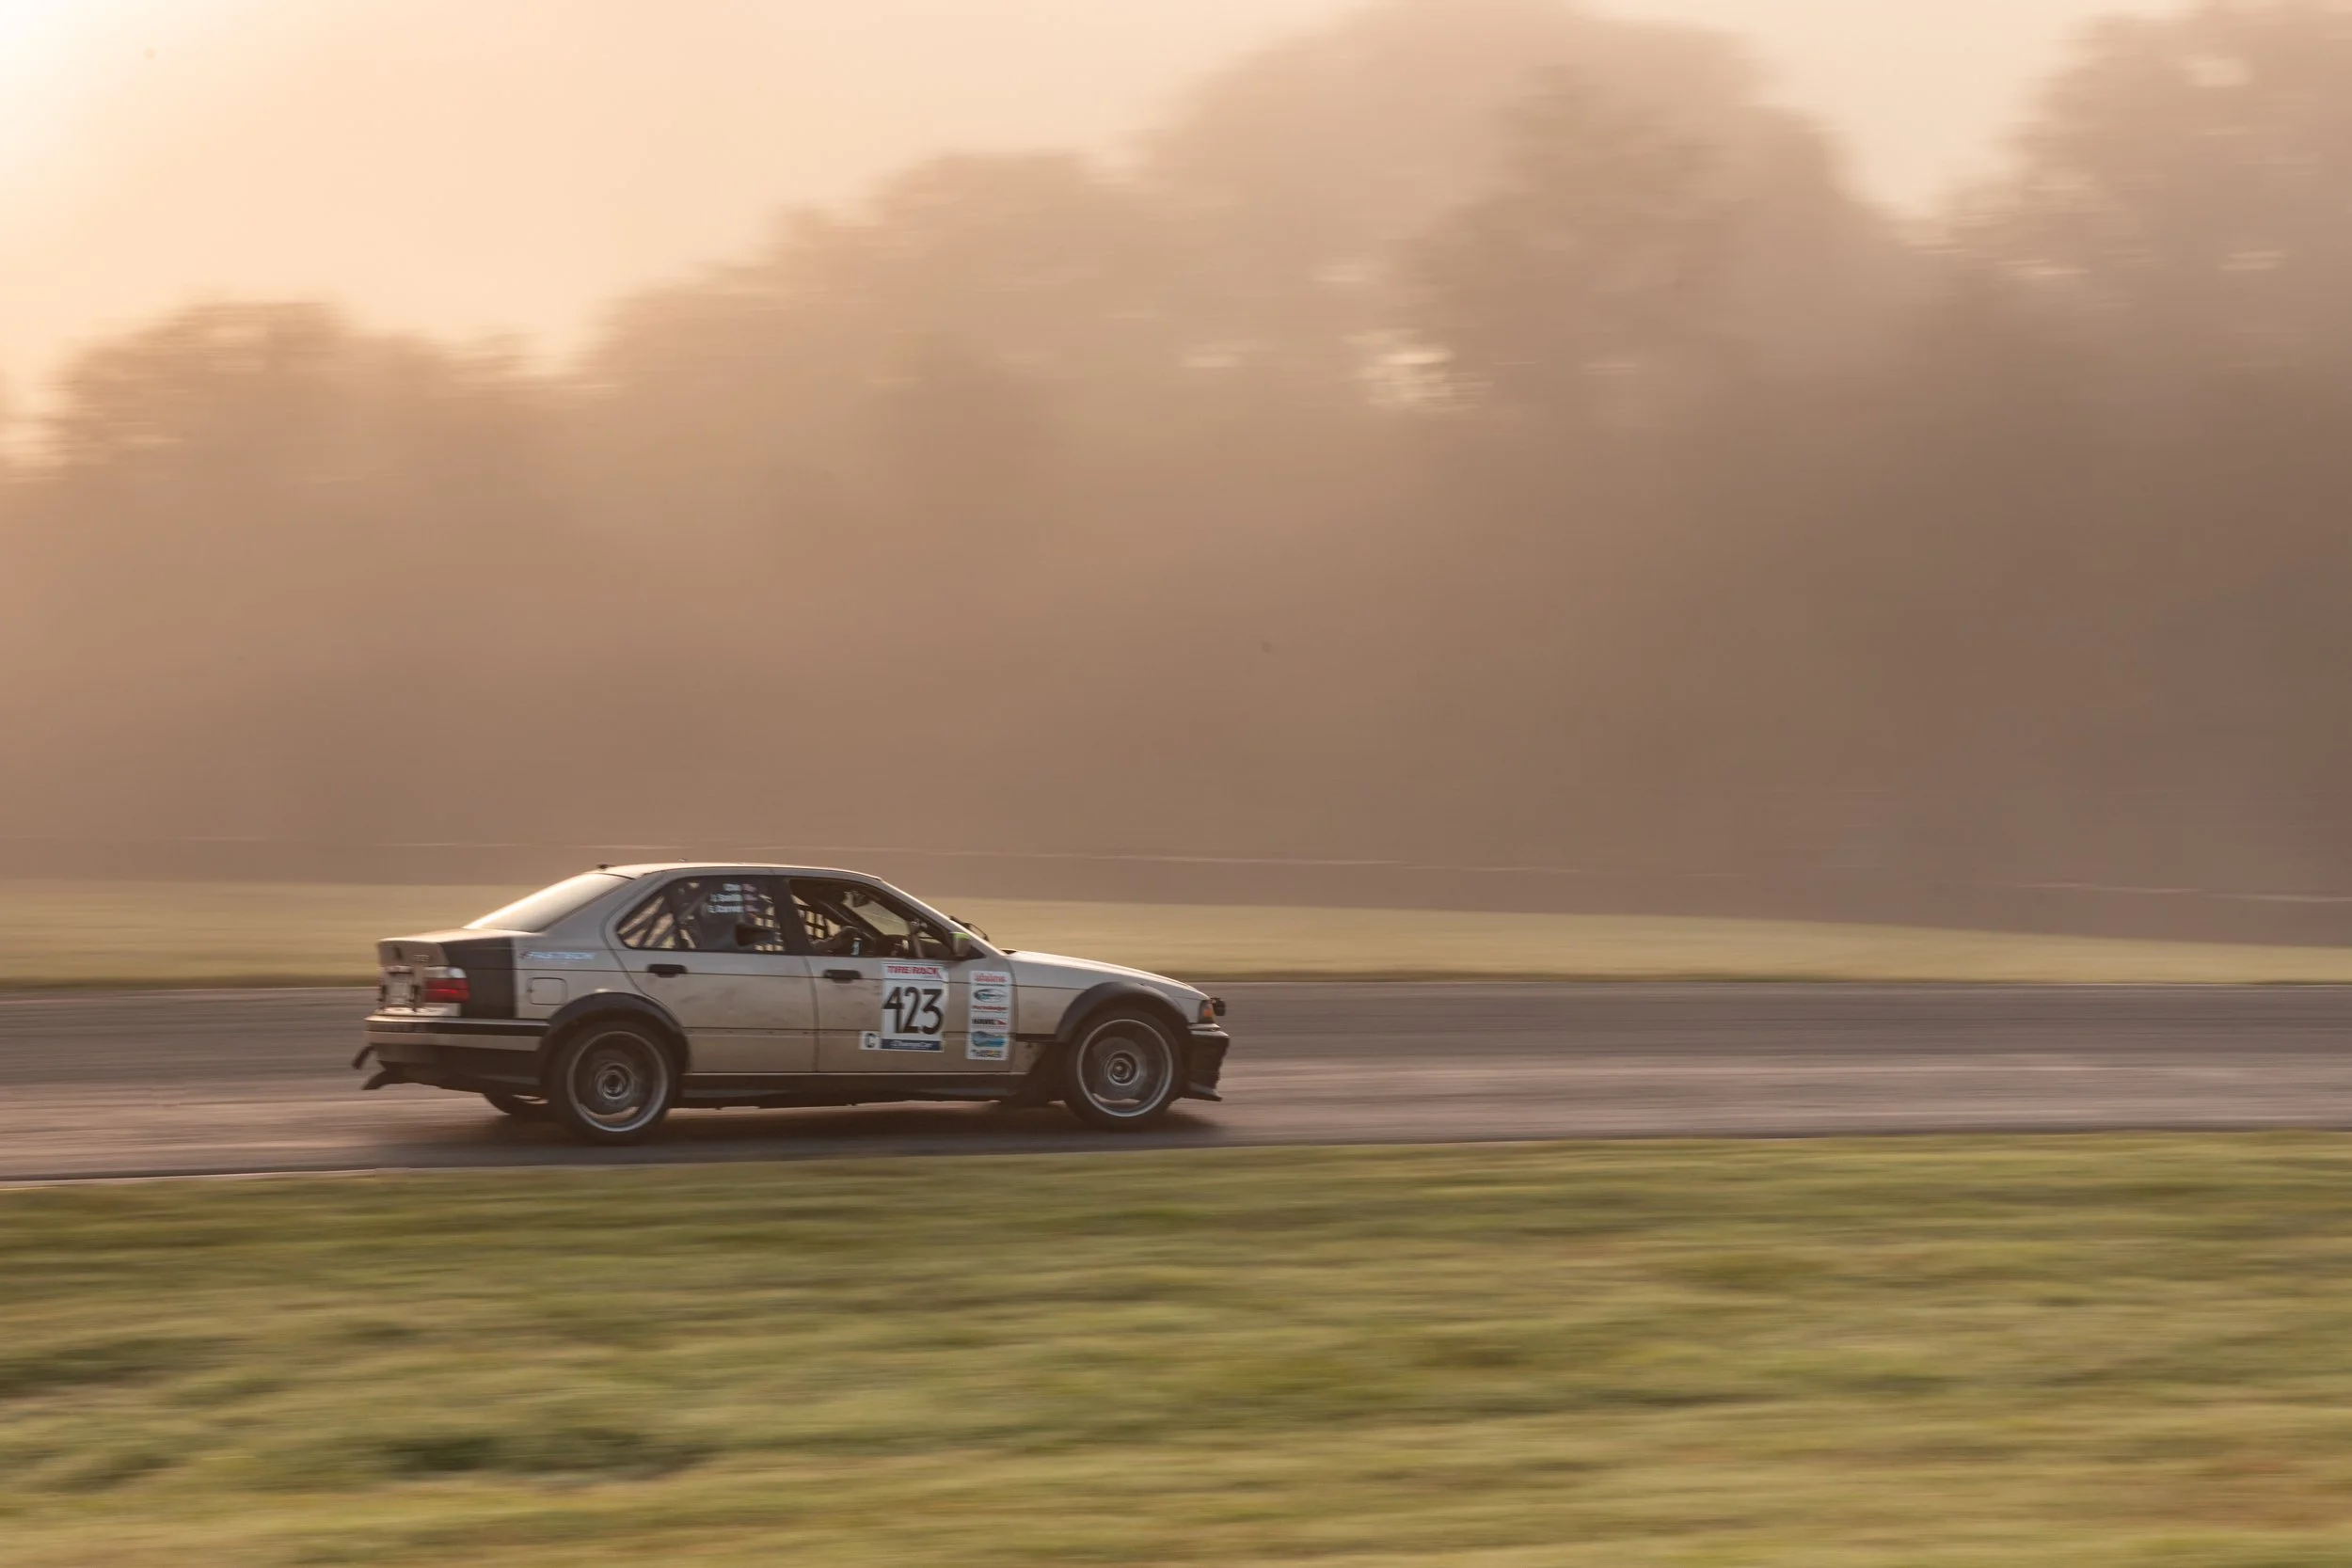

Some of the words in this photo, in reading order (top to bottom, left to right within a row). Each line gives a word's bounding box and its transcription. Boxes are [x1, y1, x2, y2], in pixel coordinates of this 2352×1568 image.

[887, 966, 909, 974] TIRE
[913, 966, 940, 975] RACK
[882, 987, 944, 1035] 423
[865, 1033, 876, 1048] C
